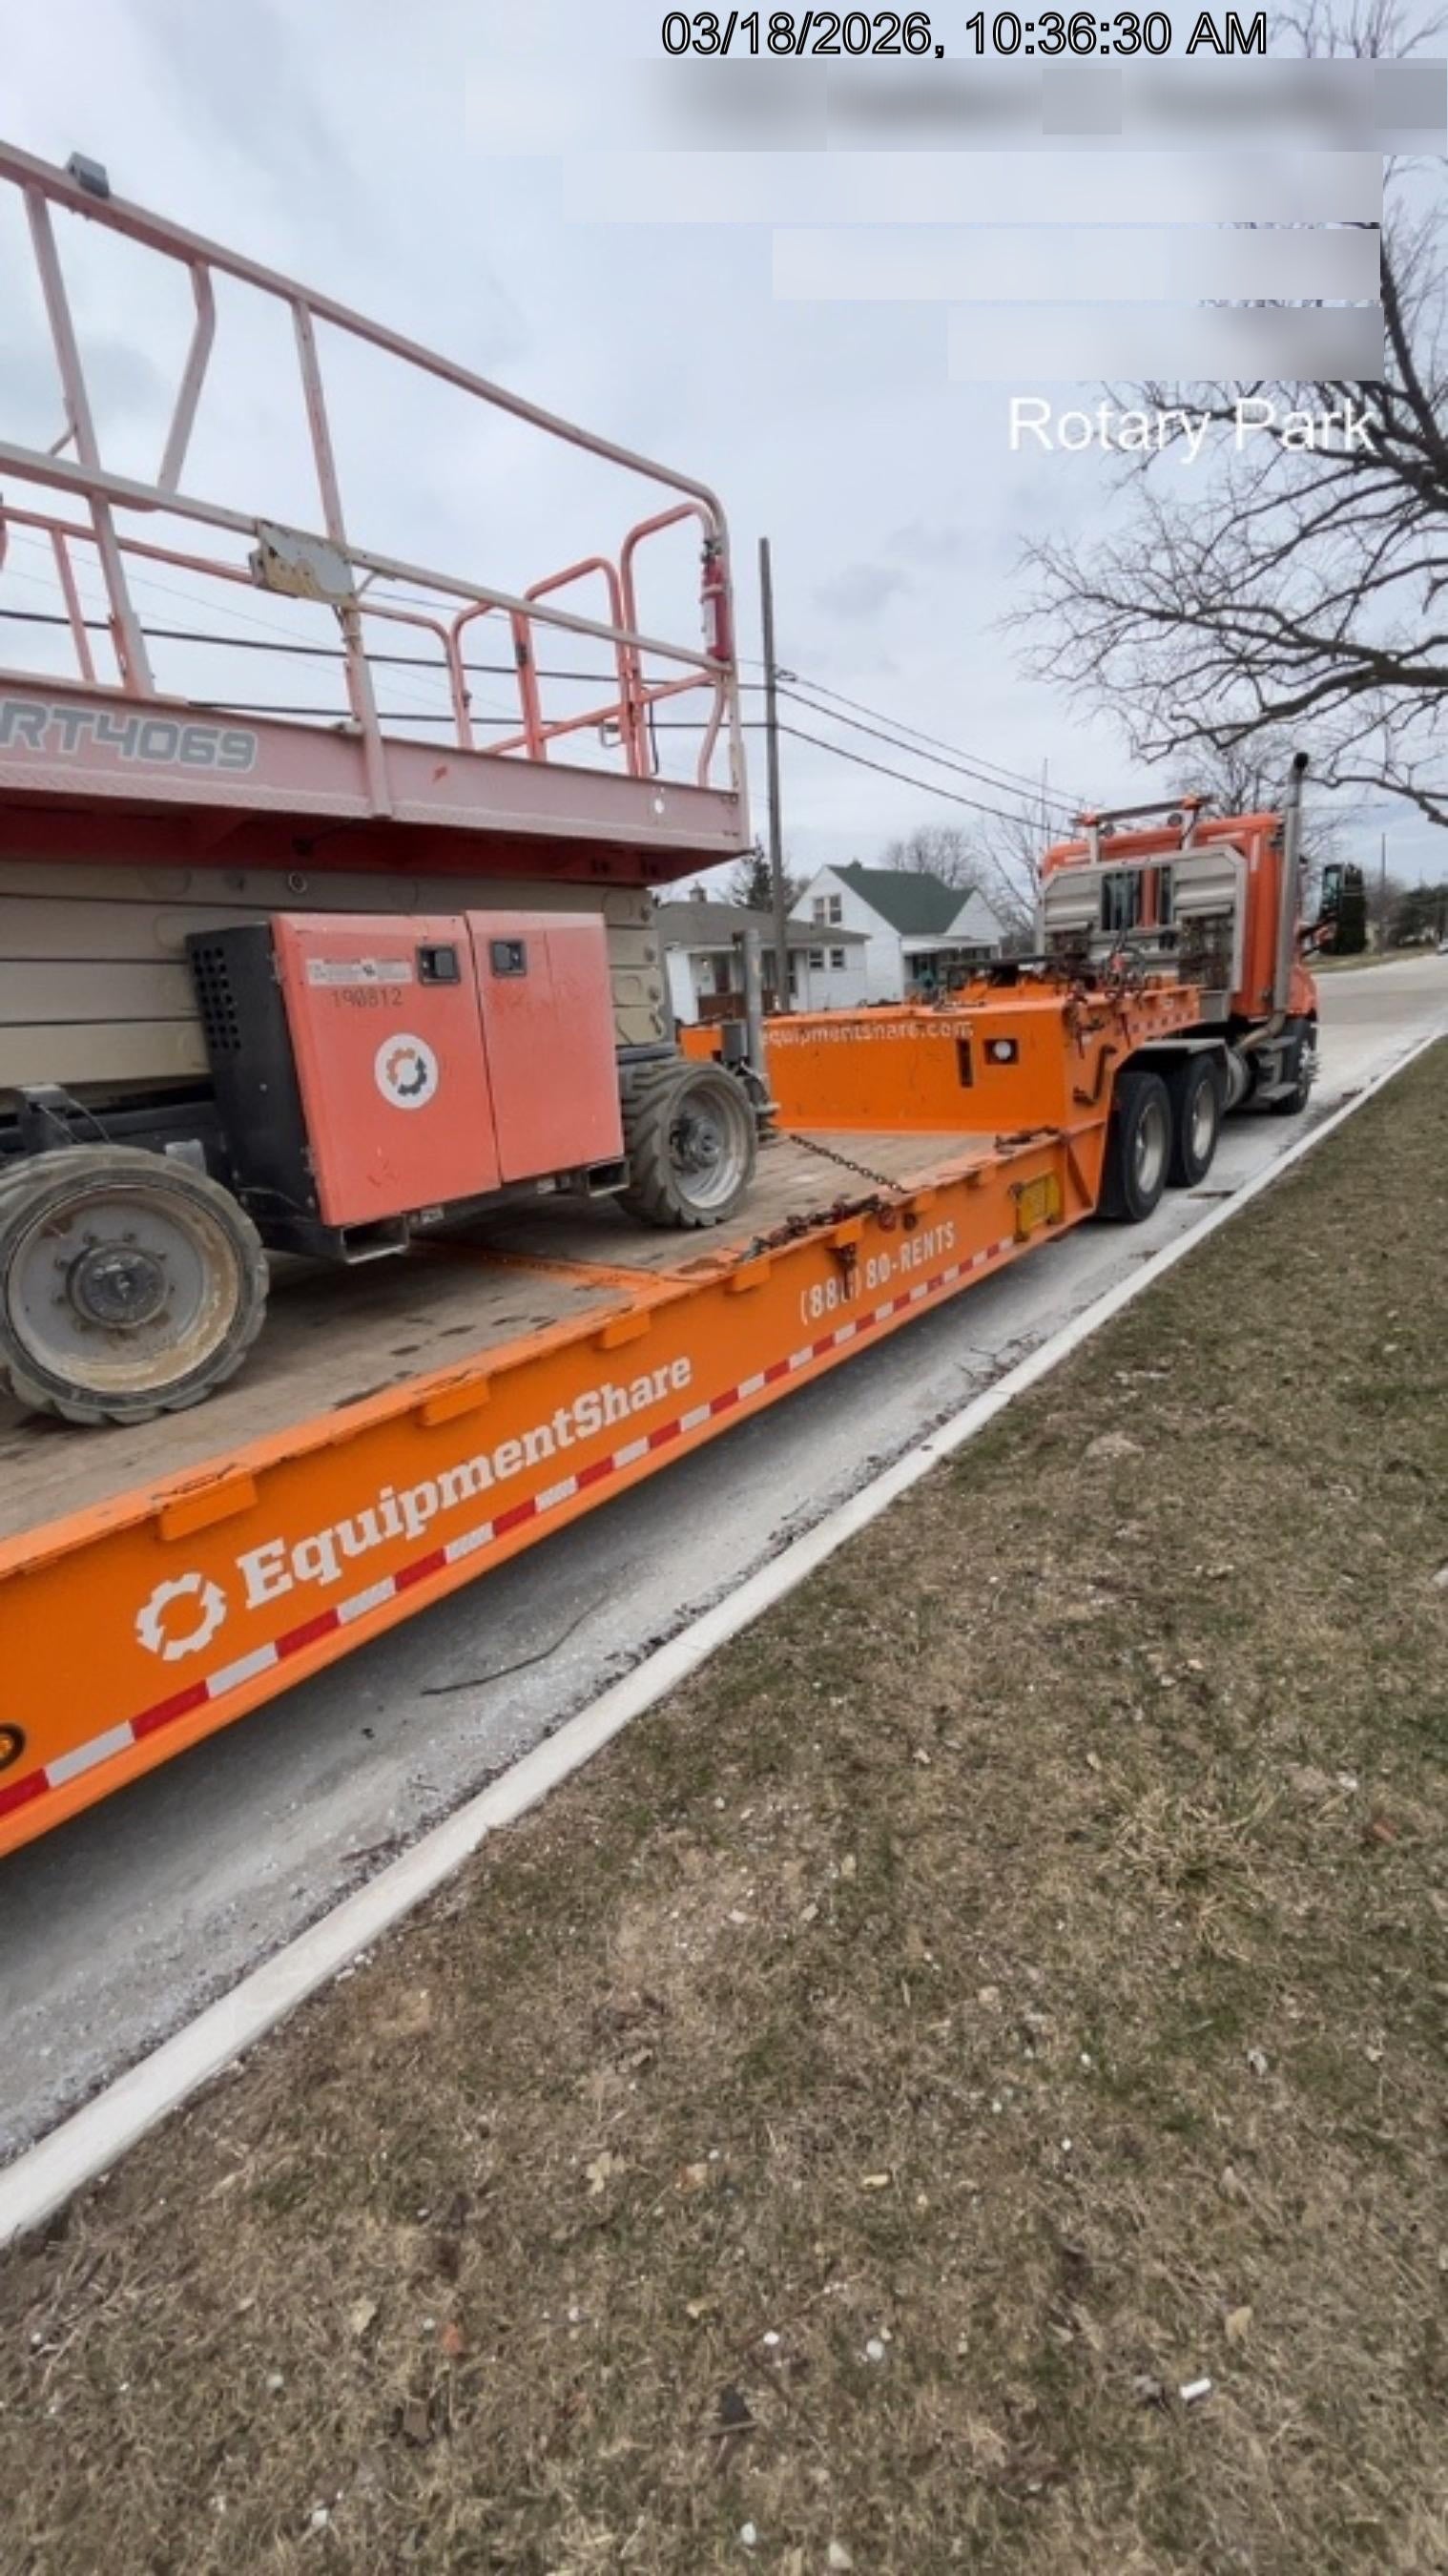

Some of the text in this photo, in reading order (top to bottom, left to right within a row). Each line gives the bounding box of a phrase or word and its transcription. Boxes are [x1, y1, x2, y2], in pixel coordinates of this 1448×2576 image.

[0, 698, 258, 773] RT4069
[866, 1220, 954, 1289] 80-RENTS
[236, 1356, 691, 1610] EquipmentShare
